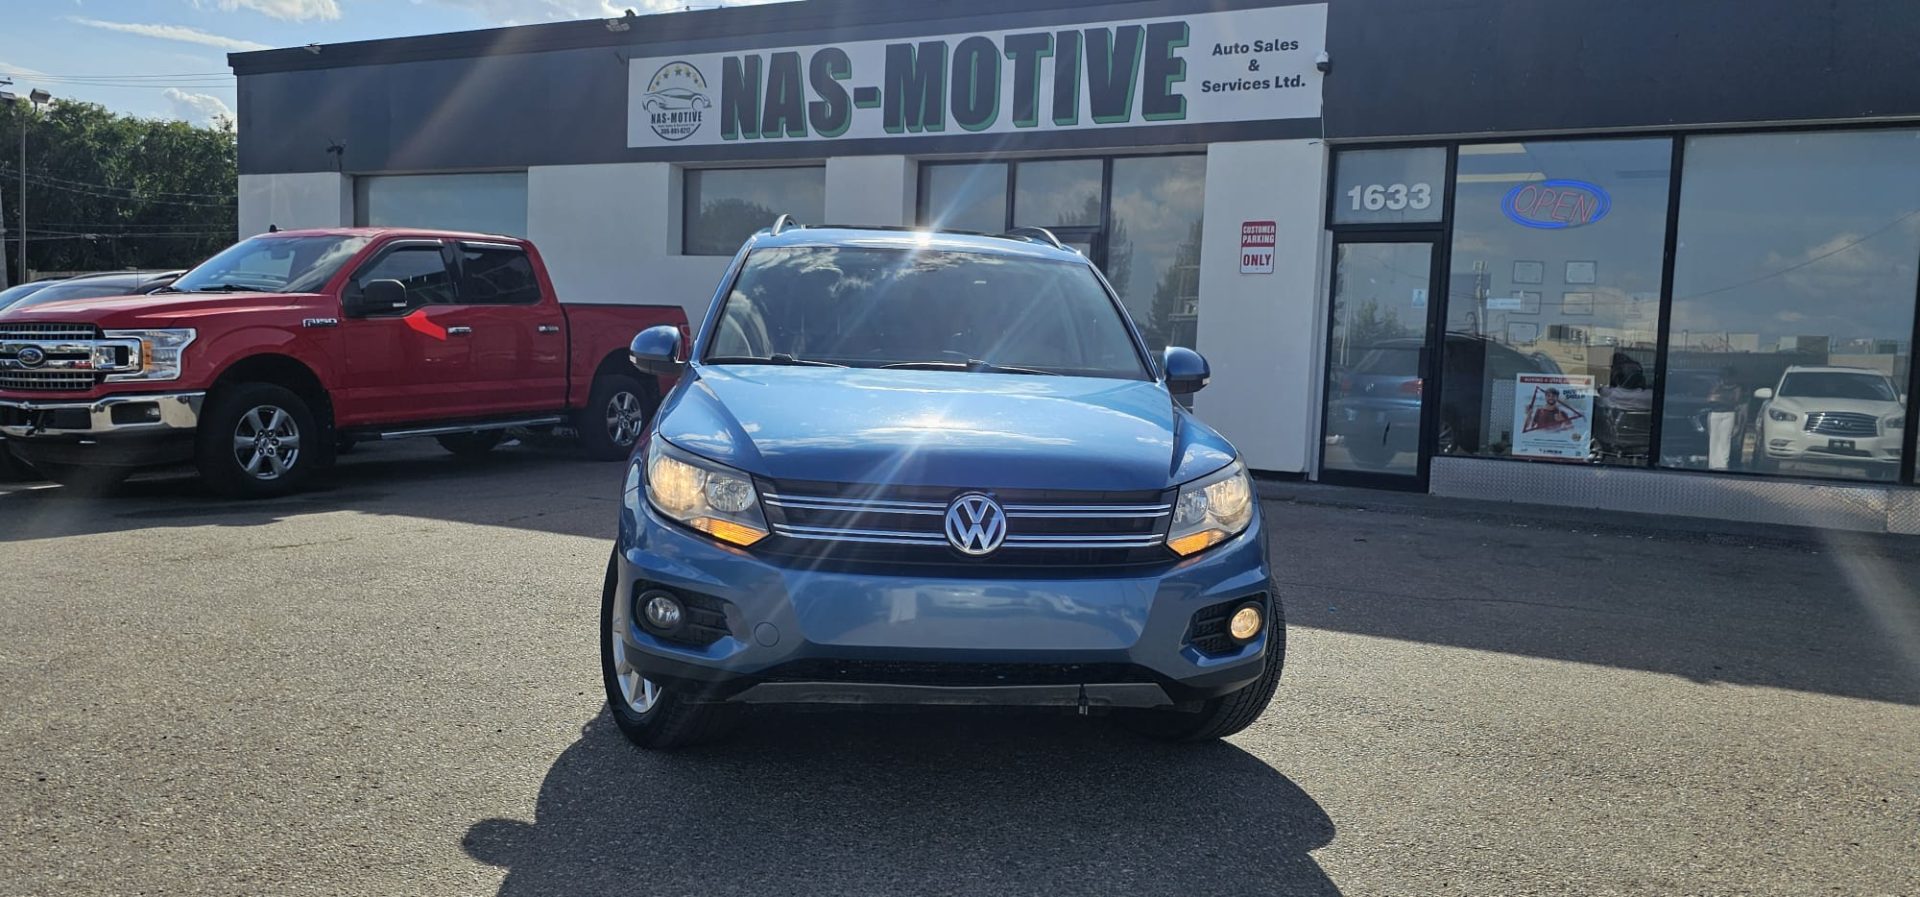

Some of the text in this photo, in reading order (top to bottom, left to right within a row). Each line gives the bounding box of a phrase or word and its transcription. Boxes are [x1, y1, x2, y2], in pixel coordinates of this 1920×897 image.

[1212, 39, 1299, 56] Auto Sales
[1248, 58, 1260, 72] &
[721, 20, 1190, 141] NAS-MOTIVE
[1201, 74, 1306, 93] Services Ltd.
[651, 111, 702, 124] NAS-MOTIVE
[1347, 183, 1432, 211] 1633
[1514, 184, 1597, 224] OPEN
[1243, 225, 1275, 234] CUSTOMER
[1242, 234, 1275, 244] PARKING
[1243, 253, 1272, 266] ONLY
